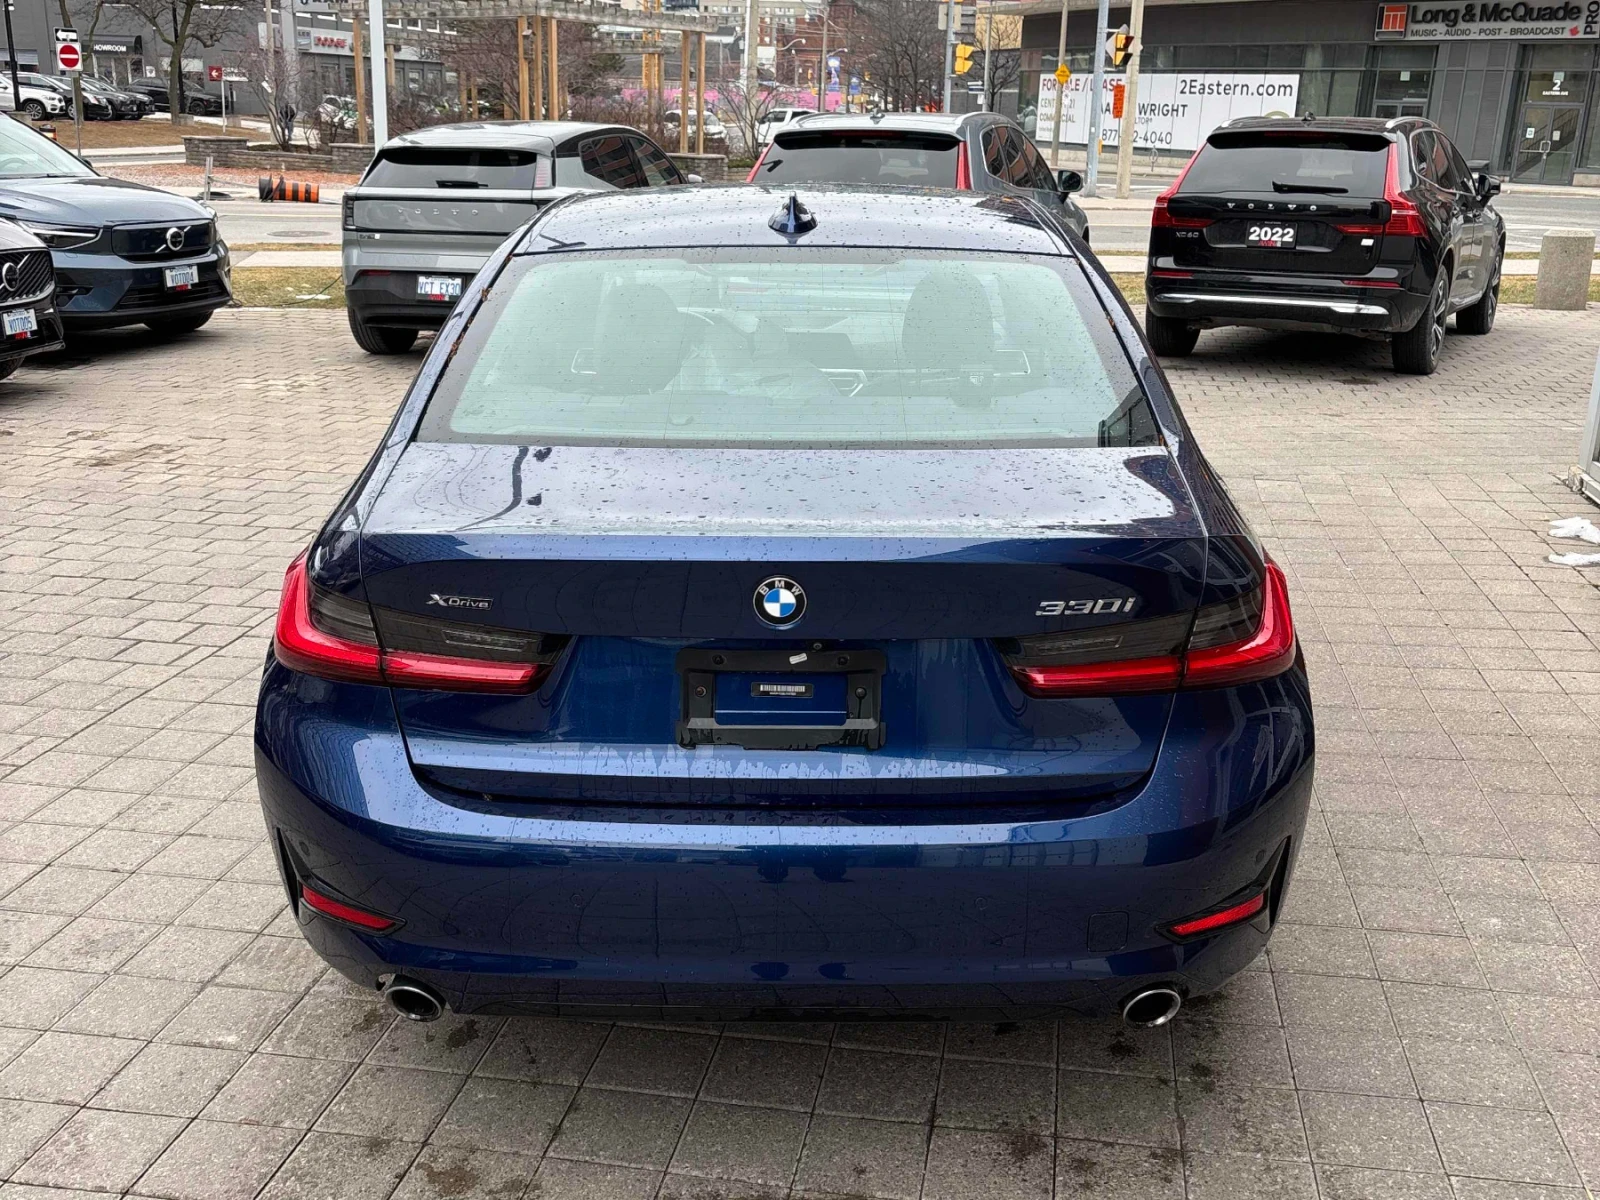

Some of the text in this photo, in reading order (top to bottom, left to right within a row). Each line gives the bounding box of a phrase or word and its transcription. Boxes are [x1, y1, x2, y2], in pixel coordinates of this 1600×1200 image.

[1410, 2, 1581, 28] Long & McQuade
[1583, 0, 1600, 35] PRO
[1410, 28, 1438, 37] MUSIC
[1444, 28, 1471, 37] AUDIO
[1478, 28, 1502, 36] POST
[1510, 26, 1566, 36] BROADCAST
[93, 44, 127, 52] HOWROOM
[1041, 78, 1058, 91] FOR
[1179, 79, 1293, 97] 2Eastern.com
[1552, 79, 1561, 91] 2
[1138, 103, 1188, 117] WRIGHT
[1248, 226, 1295, 242] 2022
[758, 579, 802, 596] BMW
[1035, 597, 1136, 616] 330i
